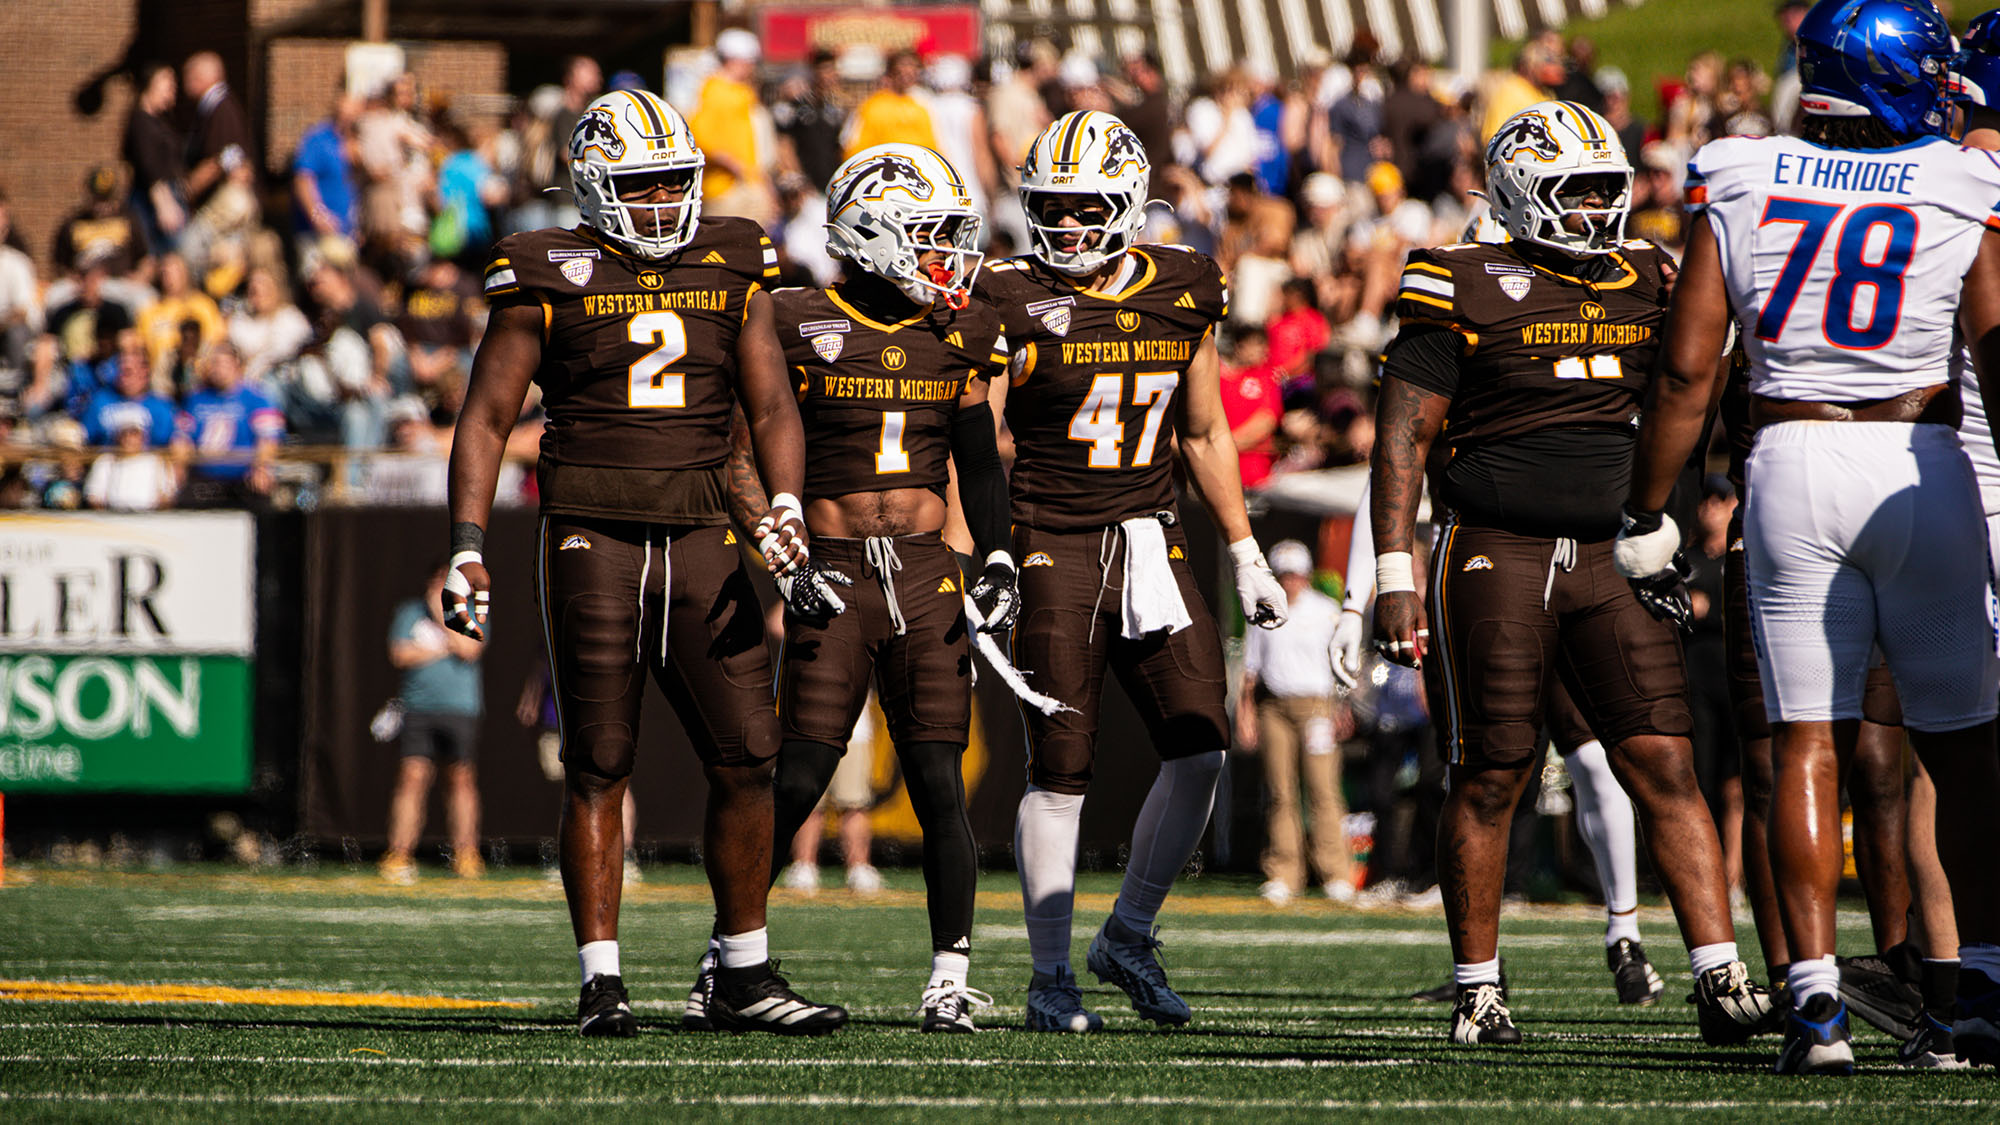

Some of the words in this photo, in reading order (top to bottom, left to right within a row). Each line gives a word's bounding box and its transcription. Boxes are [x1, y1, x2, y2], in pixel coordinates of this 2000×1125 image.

[652, 151, 677, 161] GRIT
[1593, 151, 1611, 160] GRIT
[1051, 175, 1075, 185] GRIT
[1774, 153, 1920, 195] ETHRIDGE
[958, 198, 972, 207] GRIT
[641, 274, 657, 287] W
[1754, 195, 1920, 350] 78
[583, 294, 654, 316] WESTERN
[660, 290, 728, 312] MICHIGAN
[1585, 304, 1601, 318] W
[1119, 312, 1135, 328] W
[1522, 323, 1588, 345] WESTERN
[1592, 323, 1651, 345] MICHIGAN
[627, 308, 688, 409] 2
[885, 351, 901, 366] W
[1061, 340, 1129, 364] WESTERN
[1133, 339, 1191, 362] MICHIGAN
[824, 376, 894, 400] WESTERN
[899, 379, 959, 401] MICHIGAN
[1067, 371, 1180, 469] 47
[874, 410, 911, 475] 1
